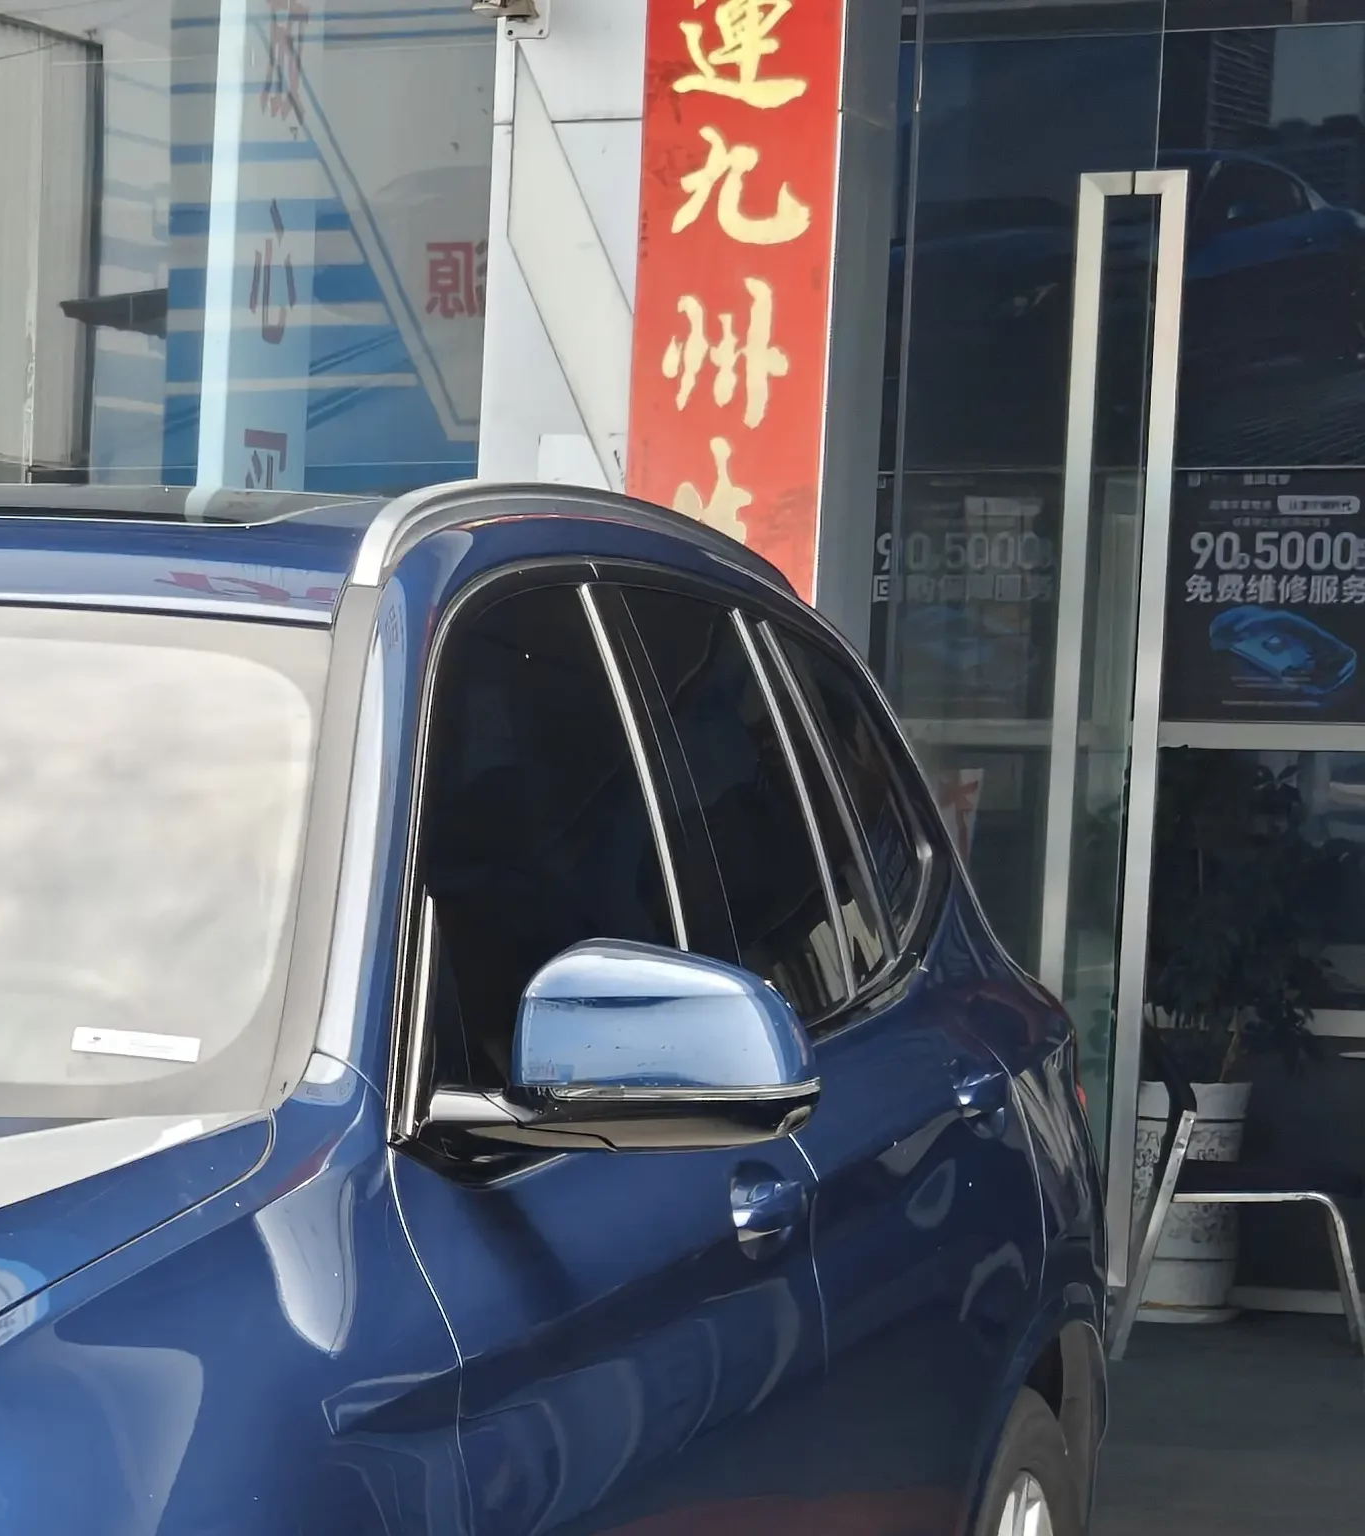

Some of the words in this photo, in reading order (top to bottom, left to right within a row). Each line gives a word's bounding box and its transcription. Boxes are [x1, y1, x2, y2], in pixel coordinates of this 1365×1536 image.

[1185, 574, 1365, 604] 免费维修服务
